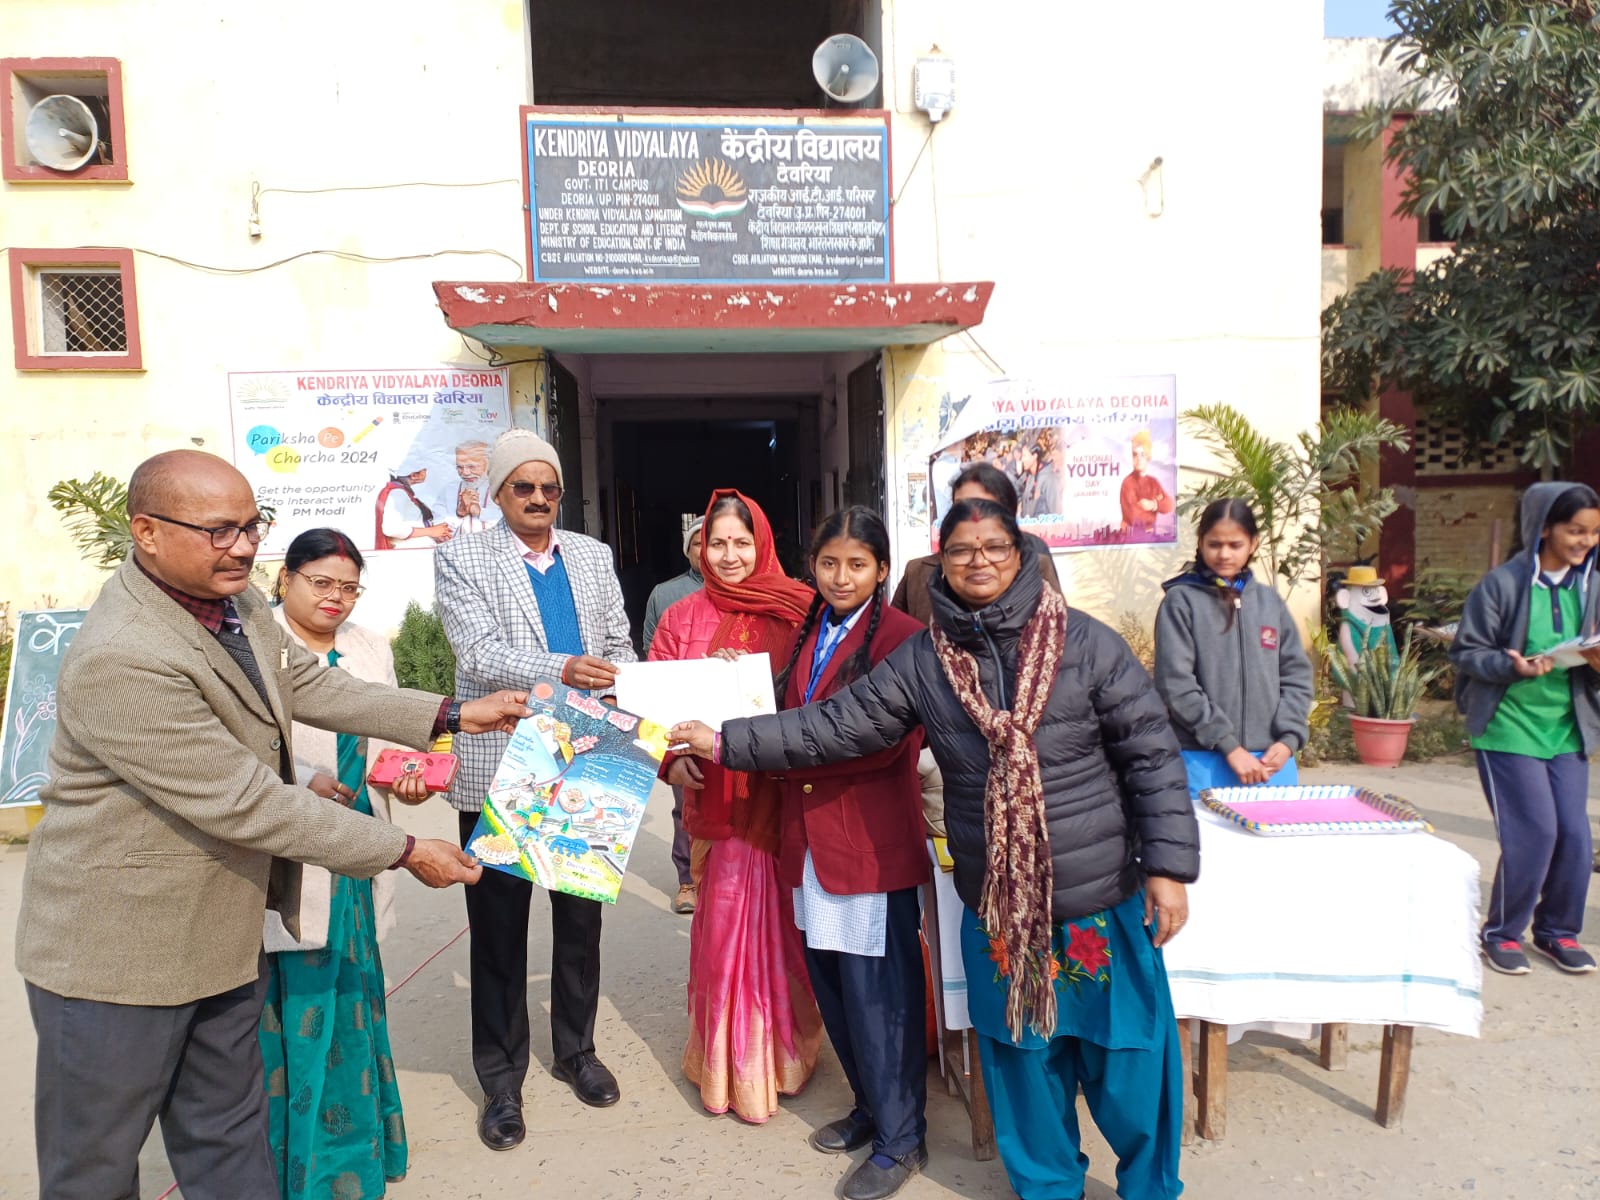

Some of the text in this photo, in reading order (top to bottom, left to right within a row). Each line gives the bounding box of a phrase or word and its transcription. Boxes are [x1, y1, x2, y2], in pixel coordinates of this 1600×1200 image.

[534, 128, 700, 159] KENDRIYA VIDYALAYA
[720, 128, 882, 164] केंद्रीय विद्यालय
[578, 160, 635, 177] DEORIA
[776, 162, 833, 184] देवरिया
[564, 178, 649, 191] GOVT. ITI CAMPUS
[561, 192, 592, 206] DEORIA
[748, 186, 787, 204] राजकीय
[846, 187, 877, 204] परिसर
[538, 208, 563, 220] UNDER
[566, 208, 600, 221] KENDRIYA
[602, 208, 642, 221] VIDYALAYA
[757, 204, 792, 219] देवरिया
[540, 223, 560, 236] DEPT.
[561, 223, 570, 236] OF
[572, 223, 597, 236] SCHOOL
[600, 223, 638, 237] EDUCATION
[641, 224, 654, 237] AND
[656, 224, 687, 237] LITERACY
[540, 236, 577, 249] MINISTRY
[580, 236, 590, 249] OF
[665, 238, 686, 251] INDIA
[297, 373, 503, 390] KENDRIYA VIDYALAYA DEORIA
[317, 391, 483, 407] केन्द्रीय विद्यालय देवरिया
[1020, 397, 1105, 412] VIDYALAYA
[1110, 395, 1169, 409] DEORIA
[251, 432, 339, 446] Pariksha Pe
[273, 450, 378, 464] Charcha 2024
[1067, 462, 1120, 478] YOUTH
[258, 484, 376, 496] Get the opportunity
[1085, 480, 1100, 488] DAY
[271, 498, 284, 506] to
[337, 494, 362, 504] with
[292, 506, 345, 517] PM Modi
[567, 691, 607, 719] विकसित
